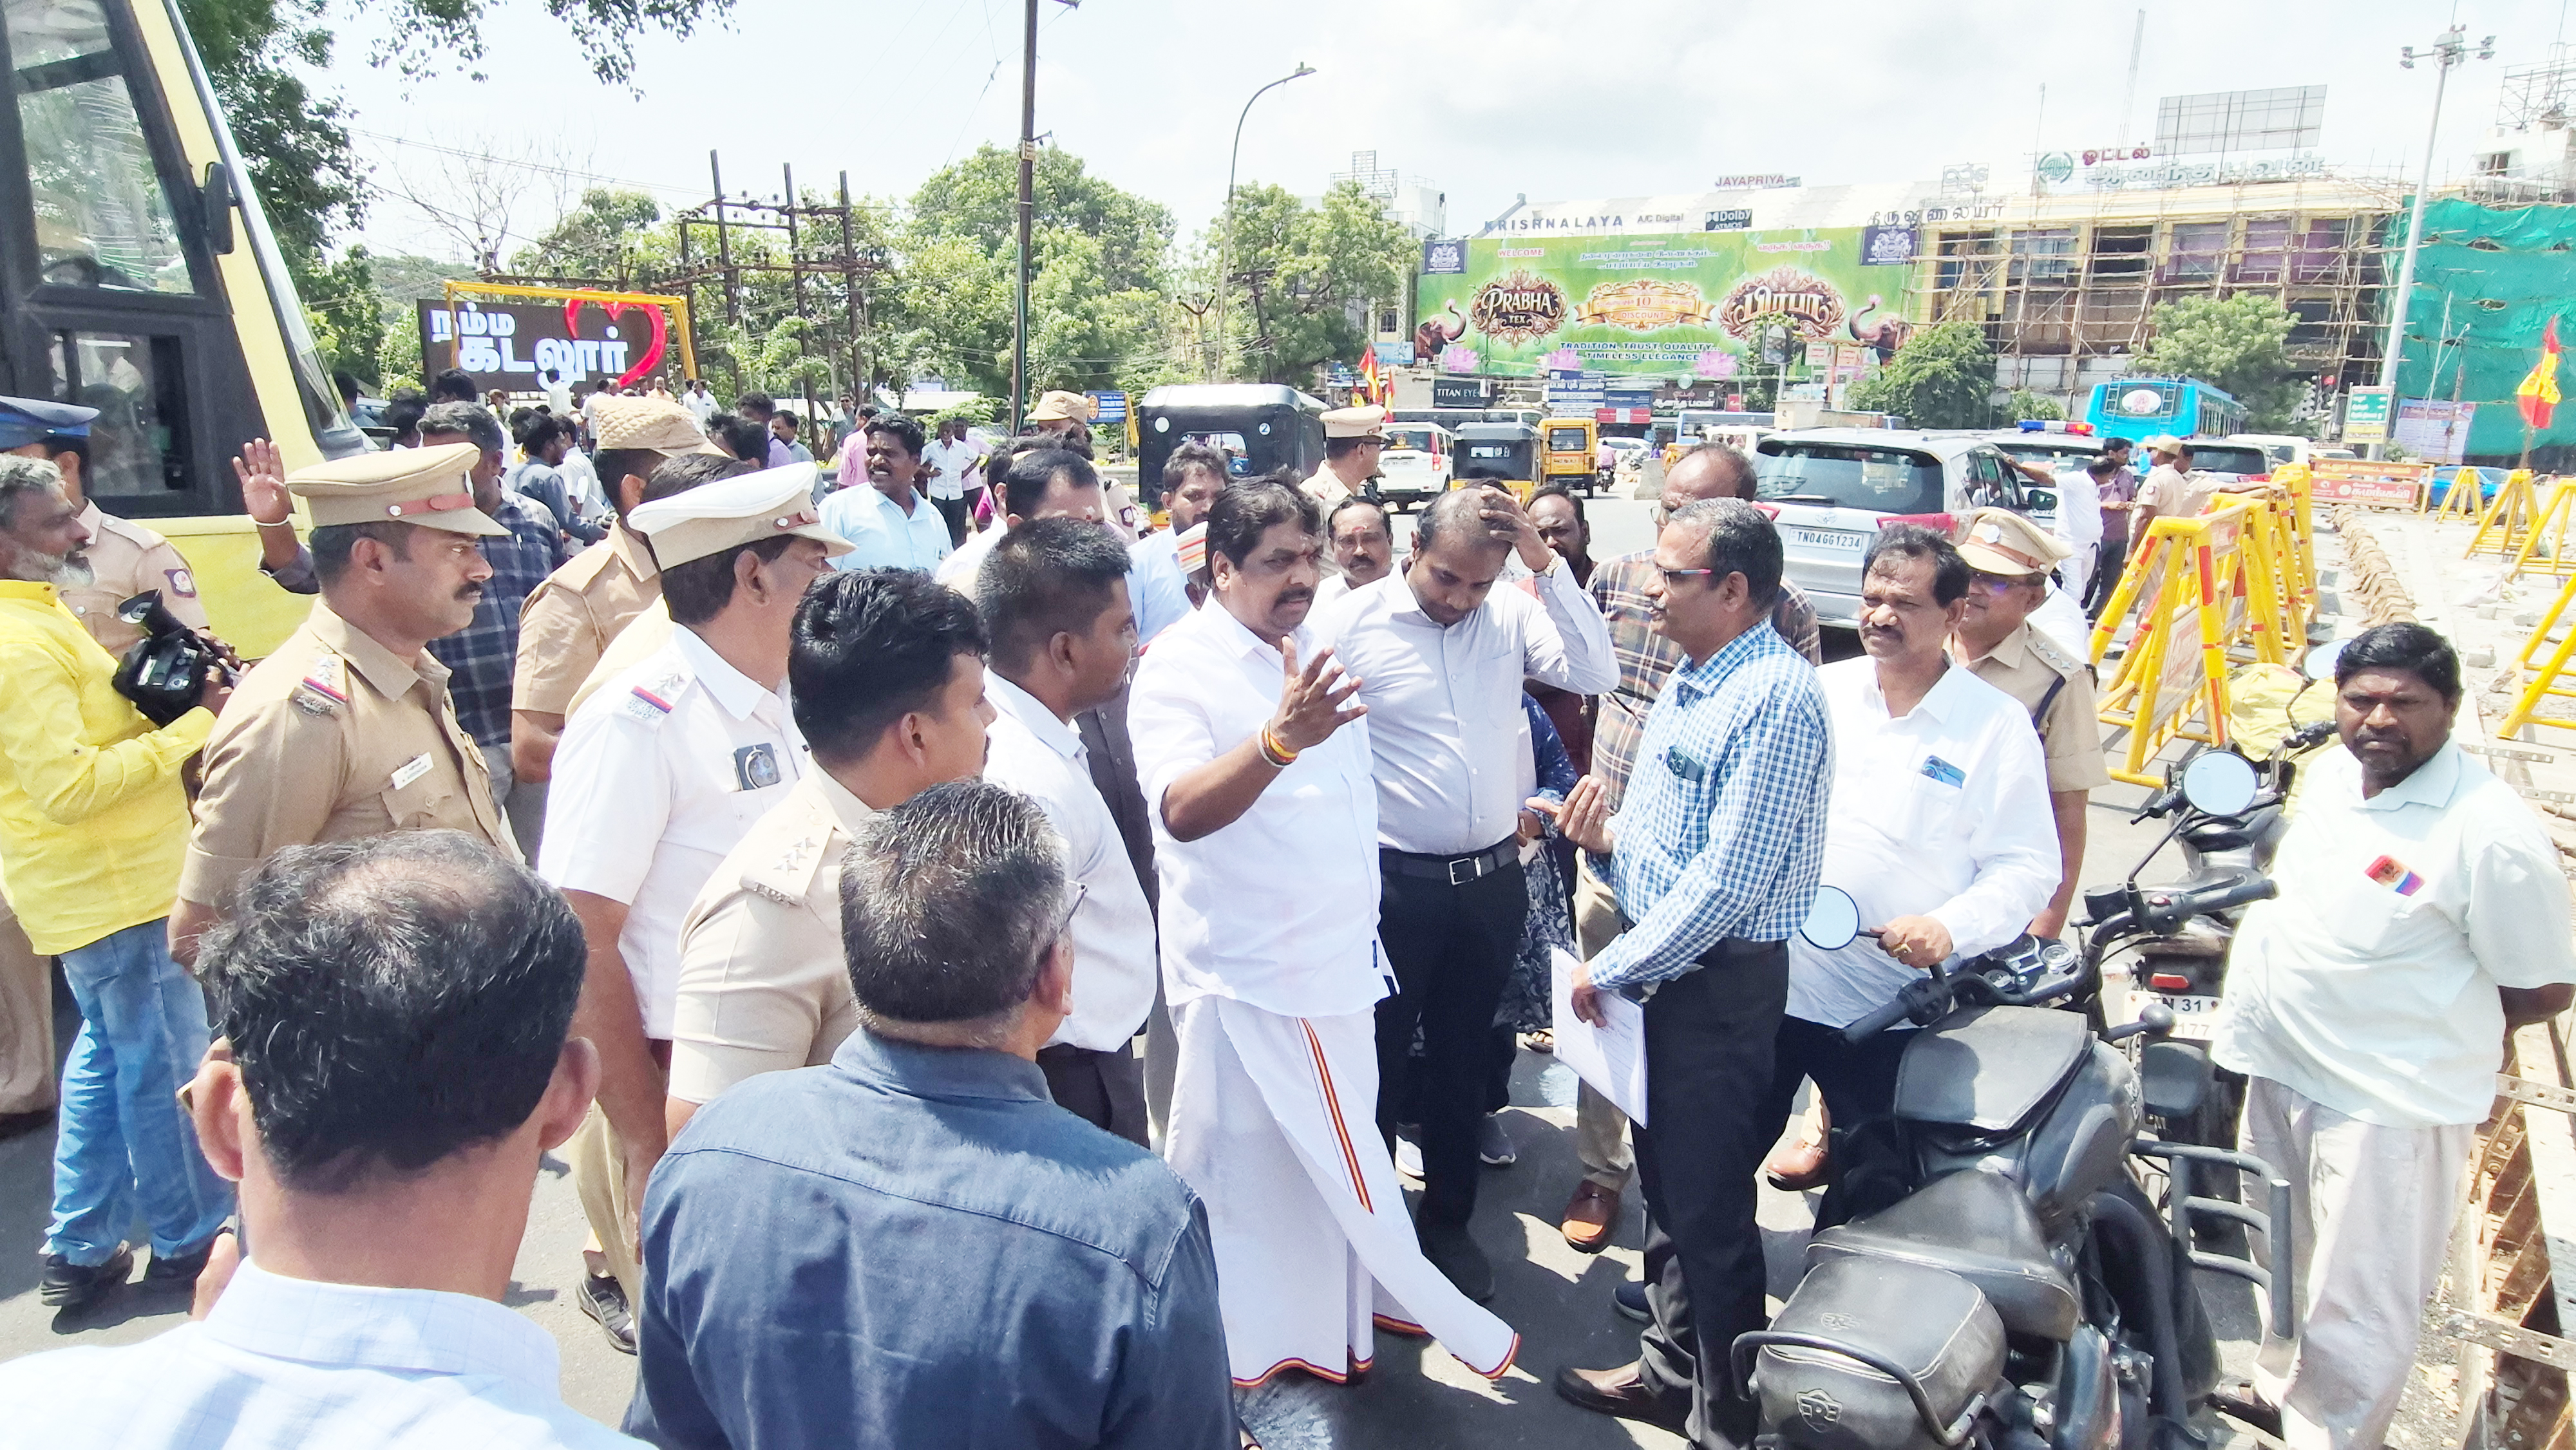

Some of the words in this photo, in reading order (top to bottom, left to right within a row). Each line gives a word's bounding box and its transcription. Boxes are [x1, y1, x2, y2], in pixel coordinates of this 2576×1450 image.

[2086, 158, 2216, 188] ஆனந்த
[2223, 151, 2324, 176] பவன்
[1715, 174, 1785, 187] JAYAPRIYA
[1656, 213, 1684, 224] Digital
[1719, 209, 1752, 223] Dolby
[1714, 222, 1743, 231] ATMOS
[1482, 288, 1555, 319] PRABHA
[1508, 315, 1526, 324] TEX
[459, 325, 629, 391] கடலூர்
[1437, 388, 1461, 397] TITAN
[1798, 531, 1861, 547] TN04GG1234
[2182, 999, 2201, 1012] 31
